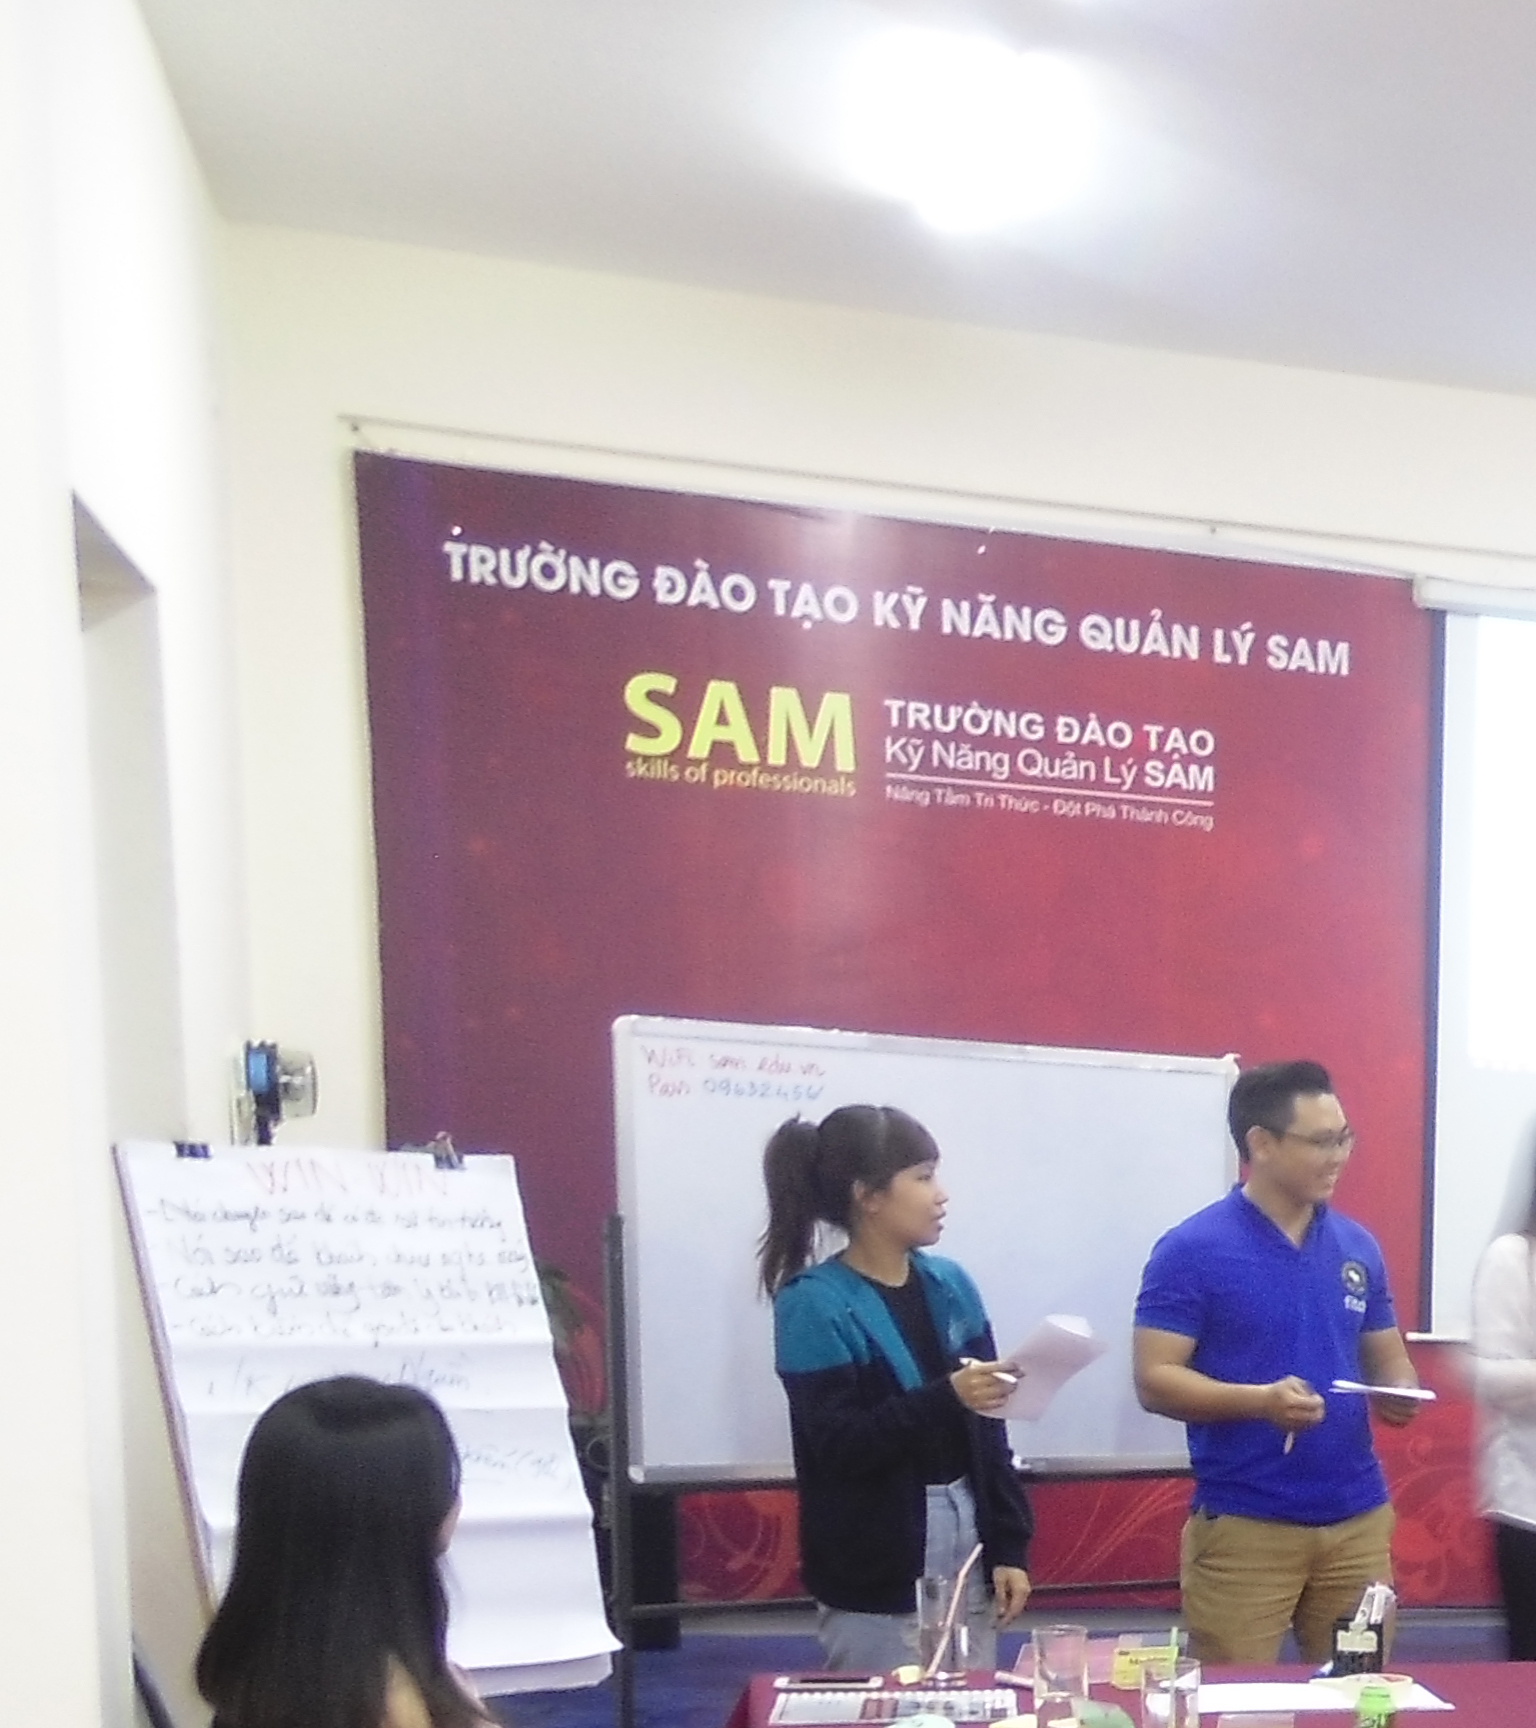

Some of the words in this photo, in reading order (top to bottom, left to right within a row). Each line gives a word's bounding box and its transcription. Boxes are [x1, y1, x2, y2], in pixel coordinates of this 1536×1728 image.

[443, 540, 640, 600] TRƯỜNG
[653, 558, 757, 612] ĐÀO
[768, 578, 859, 629] TẠO
[873, 585, 928, 630] KỸ
[942, 593, 1068, 645] NĂNG
[1079, 609, 1200, 661] QUẢN
[1213, 621, 1256, 666] LÝ
[1266, 634, 1351, 676] SAM
[624, 672, 856, 772] SAM
[884, 699, 1046, 741] TRƯỜNG
[1056, 713, 1133, 749] ĐÀO
[1142, 724, 1215, 760] TẠO
[626, 757, 680, 782] skills
[684, 761, 709, 783] of
[713, 766, 857, 797] professionals
[884, 736, 925, 771] Kỹ
[932, 740, 1010, 780] Năng
[1016, 748, 1096, 782] Quản
[1103, 756, 1137, 791] Lý
[1144, 760, 1215, 792] SAM
